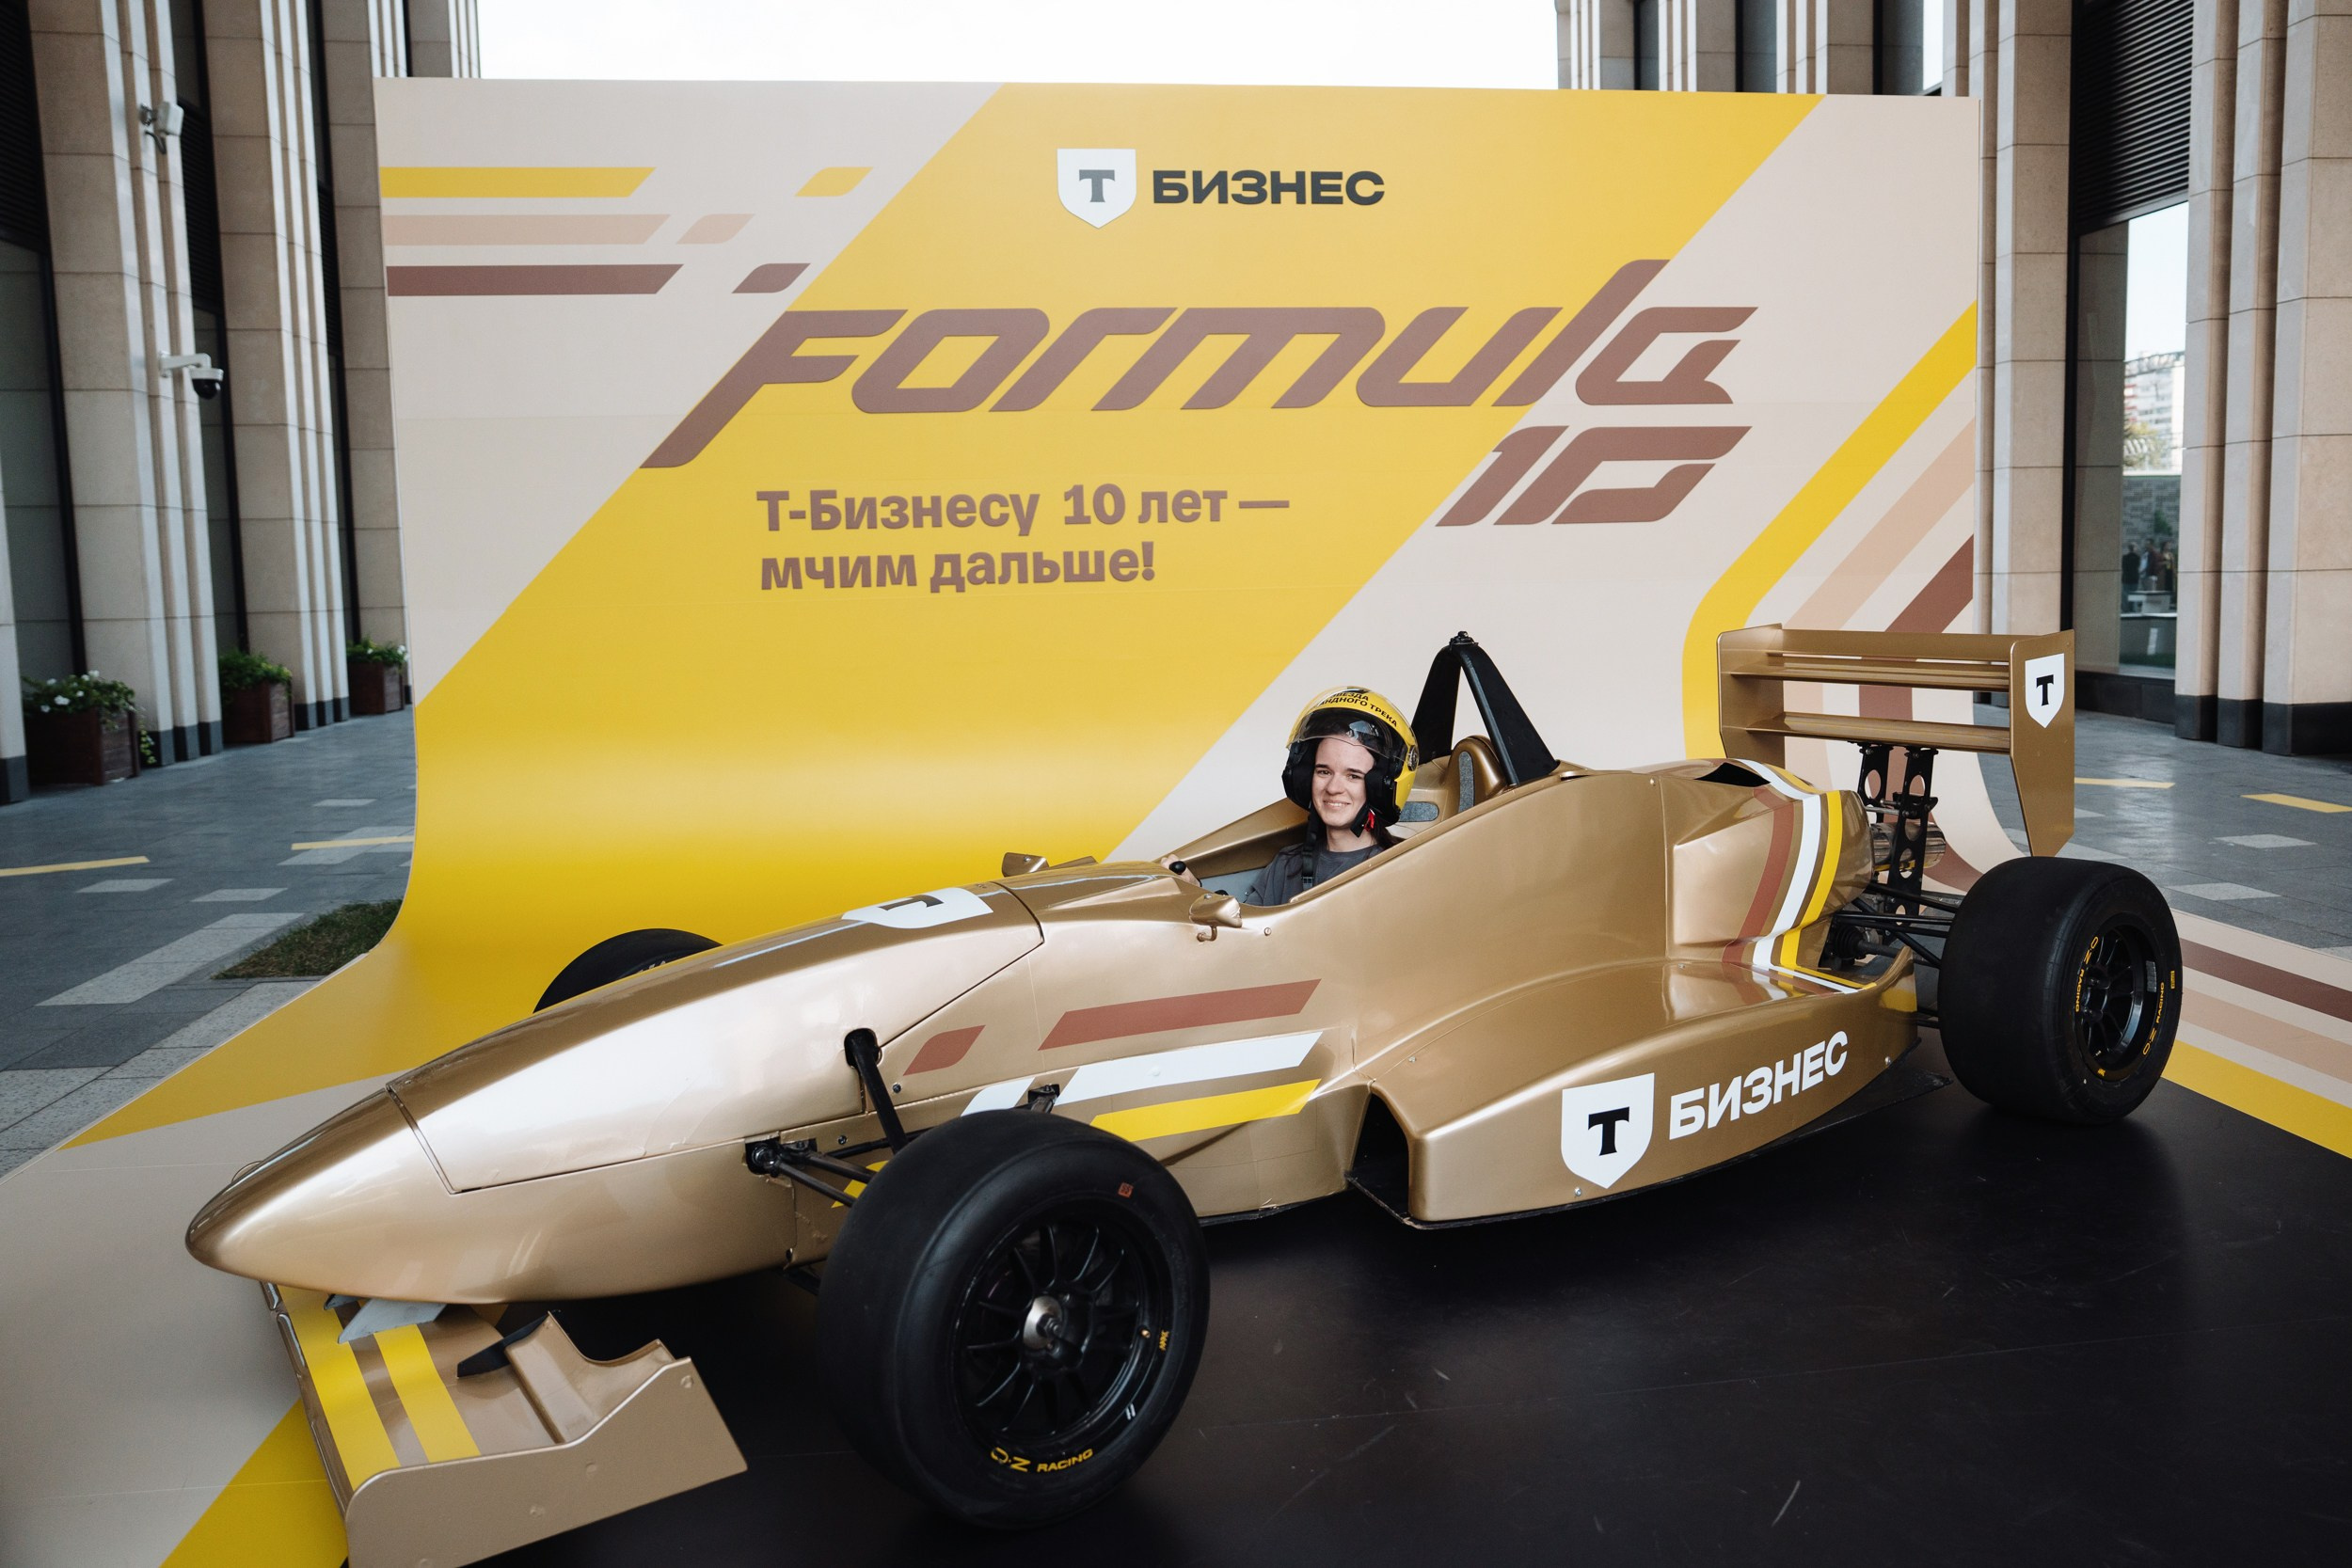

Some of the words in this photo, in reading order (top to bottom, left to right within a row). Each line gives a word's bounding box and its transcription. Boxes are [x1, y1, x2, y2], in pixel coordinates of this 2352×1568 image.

[1153, 170, 1384, 205] БИЗНЕС
[640, 260, 1758, 468] Formula
[756, 490, 1041, 536] Т-Бизнесу
[1064, 484, 1125, 525] 10
[1138, 490, 1227, 523] лет
[762, 555, 916, 590] мчим
[930, 542, 1154, 593] дальше!
[1370, 703, 1397, 727] ТРЕКА
[2155, 981, 2165, 1023] RACING
[1669, 1031, 1849, 1140] БИЗНЕС
[1037, 1449, 1093, 1472] RACING
